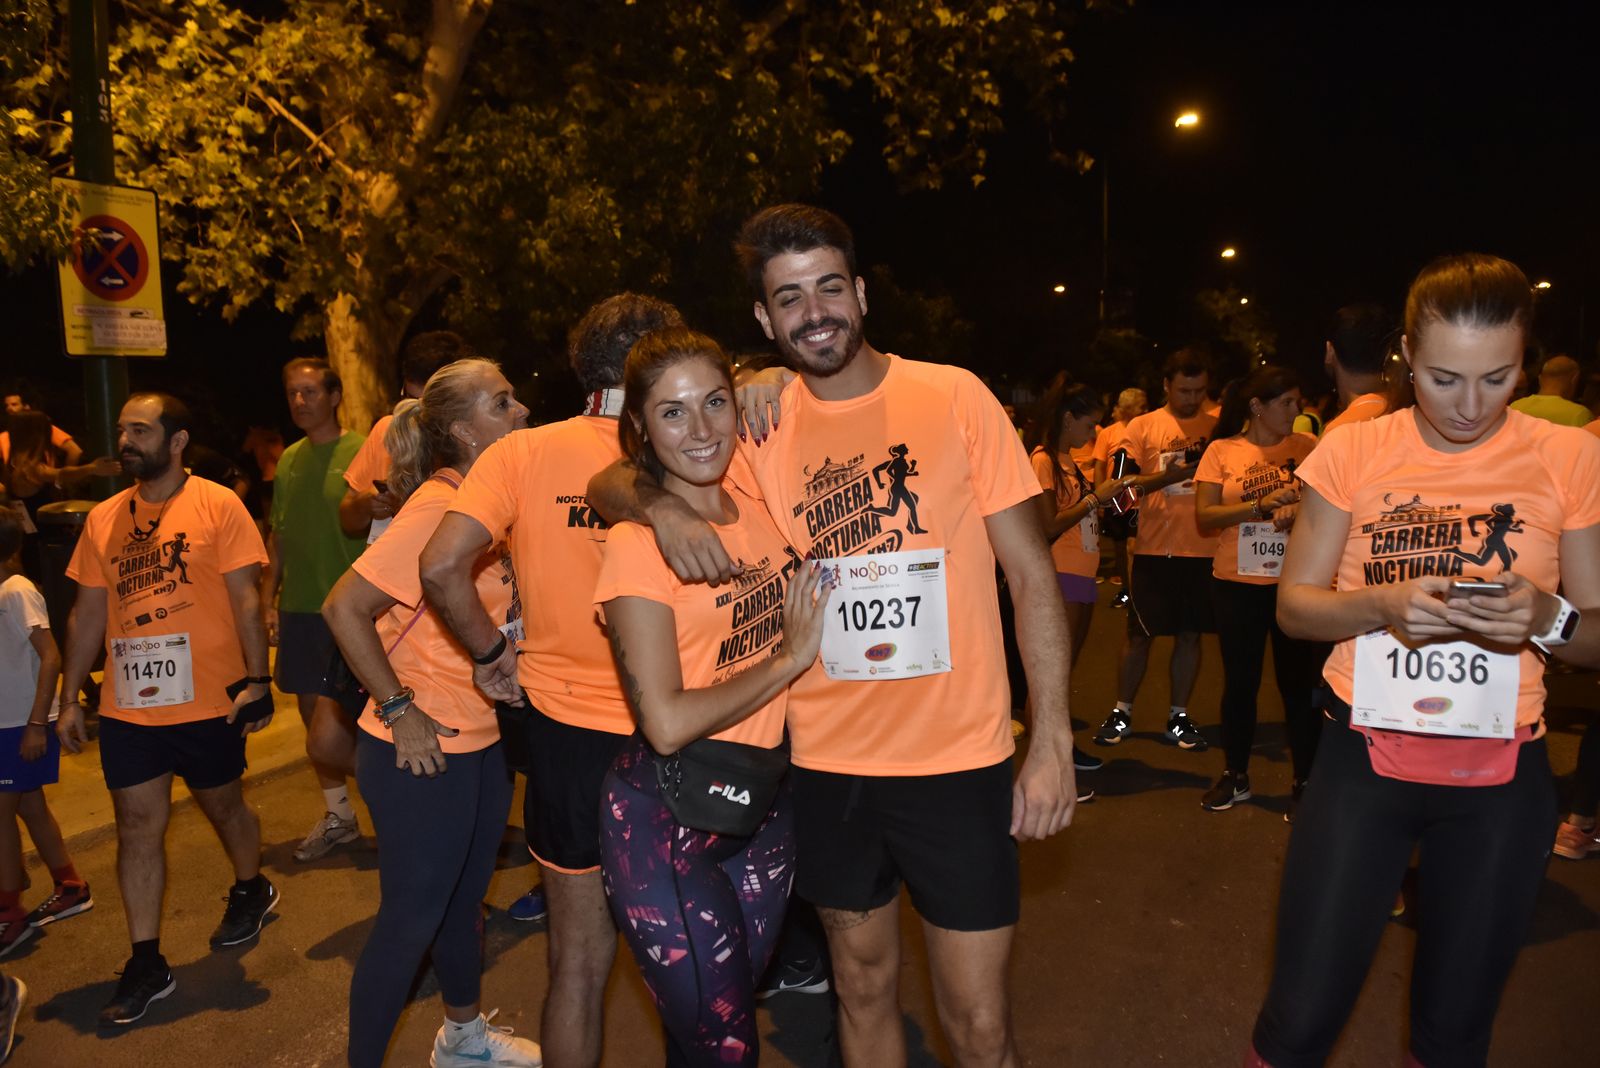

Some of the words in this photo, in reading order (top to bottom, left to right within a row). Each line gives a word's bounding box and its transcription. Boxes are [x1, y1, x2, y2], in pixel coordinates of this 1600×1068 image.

[1243, 469, 1280, 491] CARRERA
[805, 476, 874, 538] CARRERA
[1371, 521, 1462, 556] CARRERA
[118, 548, 161, 578] CARRERA
[1363, 553, 1464, 586] NOCTURNA
[715, 592, 733, 609] XXXI
[731, 577, 784, 630] CARRERA
[837, 596, 921, 632] 10237
[123, 659, 176, 681] 11470
[1386, 647, 1489, 686] 10636
[708, 780, 751, 806] FILA
